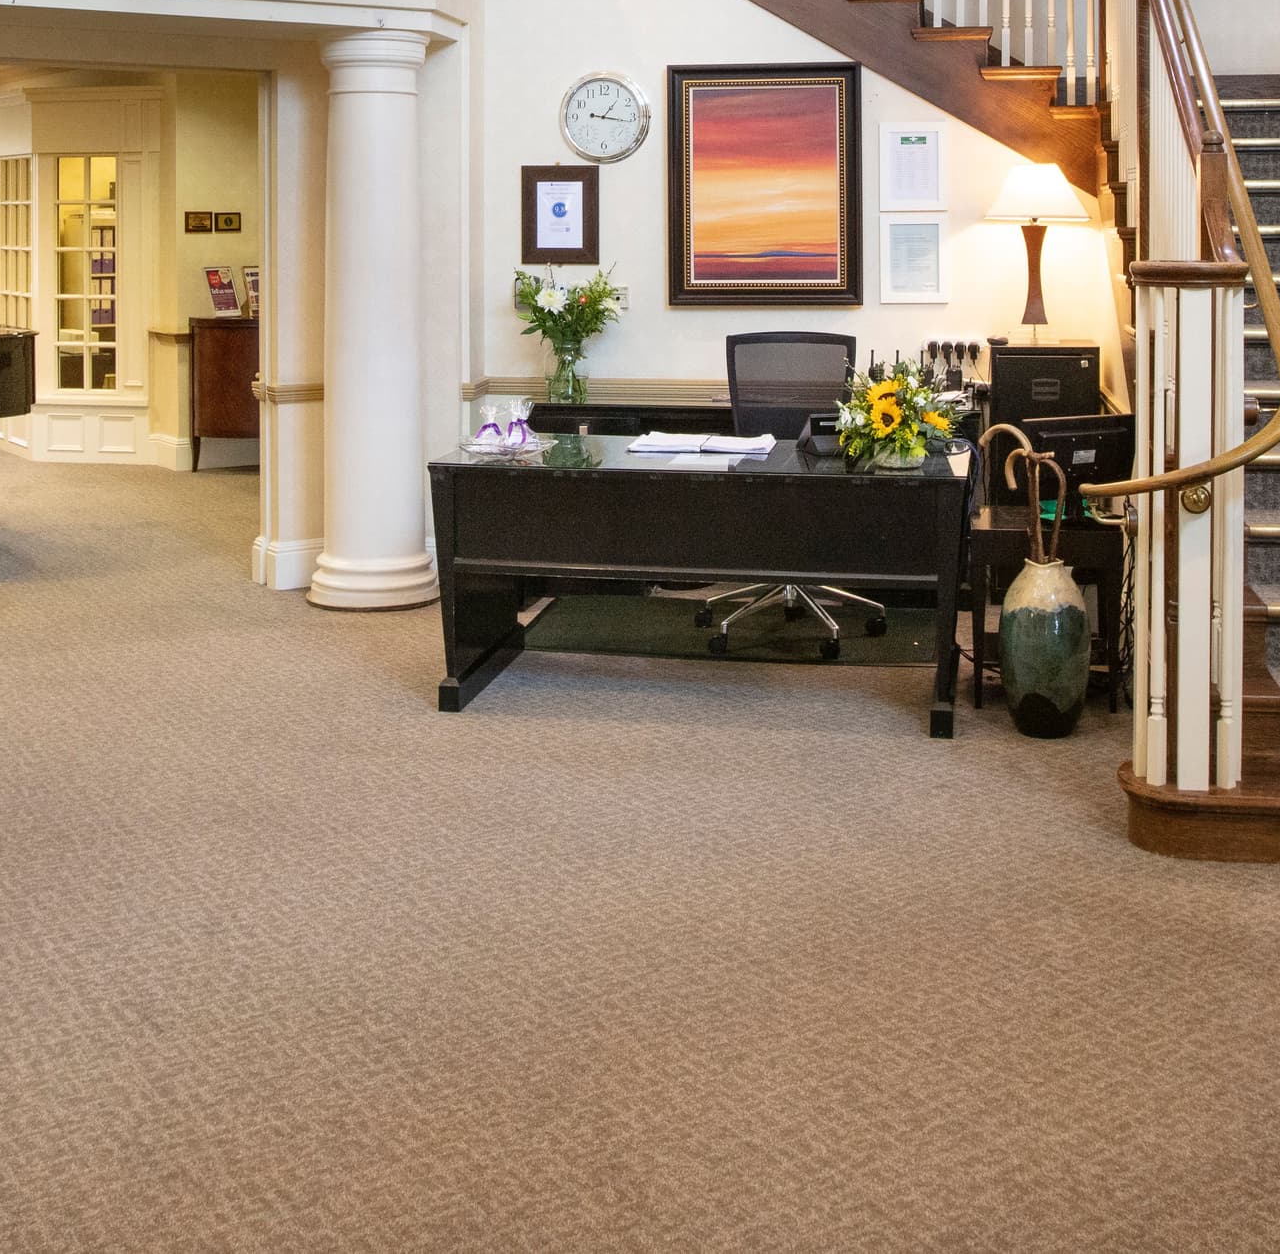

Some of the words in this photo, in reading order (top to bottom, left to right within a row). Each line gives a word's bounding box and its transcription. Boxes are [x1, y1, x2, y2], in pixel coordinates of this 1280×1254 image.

[587, 89, 595, 99] 11
[600, 85, 610, 96] 12
[616, 88, 620, 99] 1
[577, 99, 586, 109] 10
[624, 97, 632, 107] 2
[572, 113, 579, 122] 9
[629, 112, 637, 123] 3
[600, 140, 608, 150] 6
